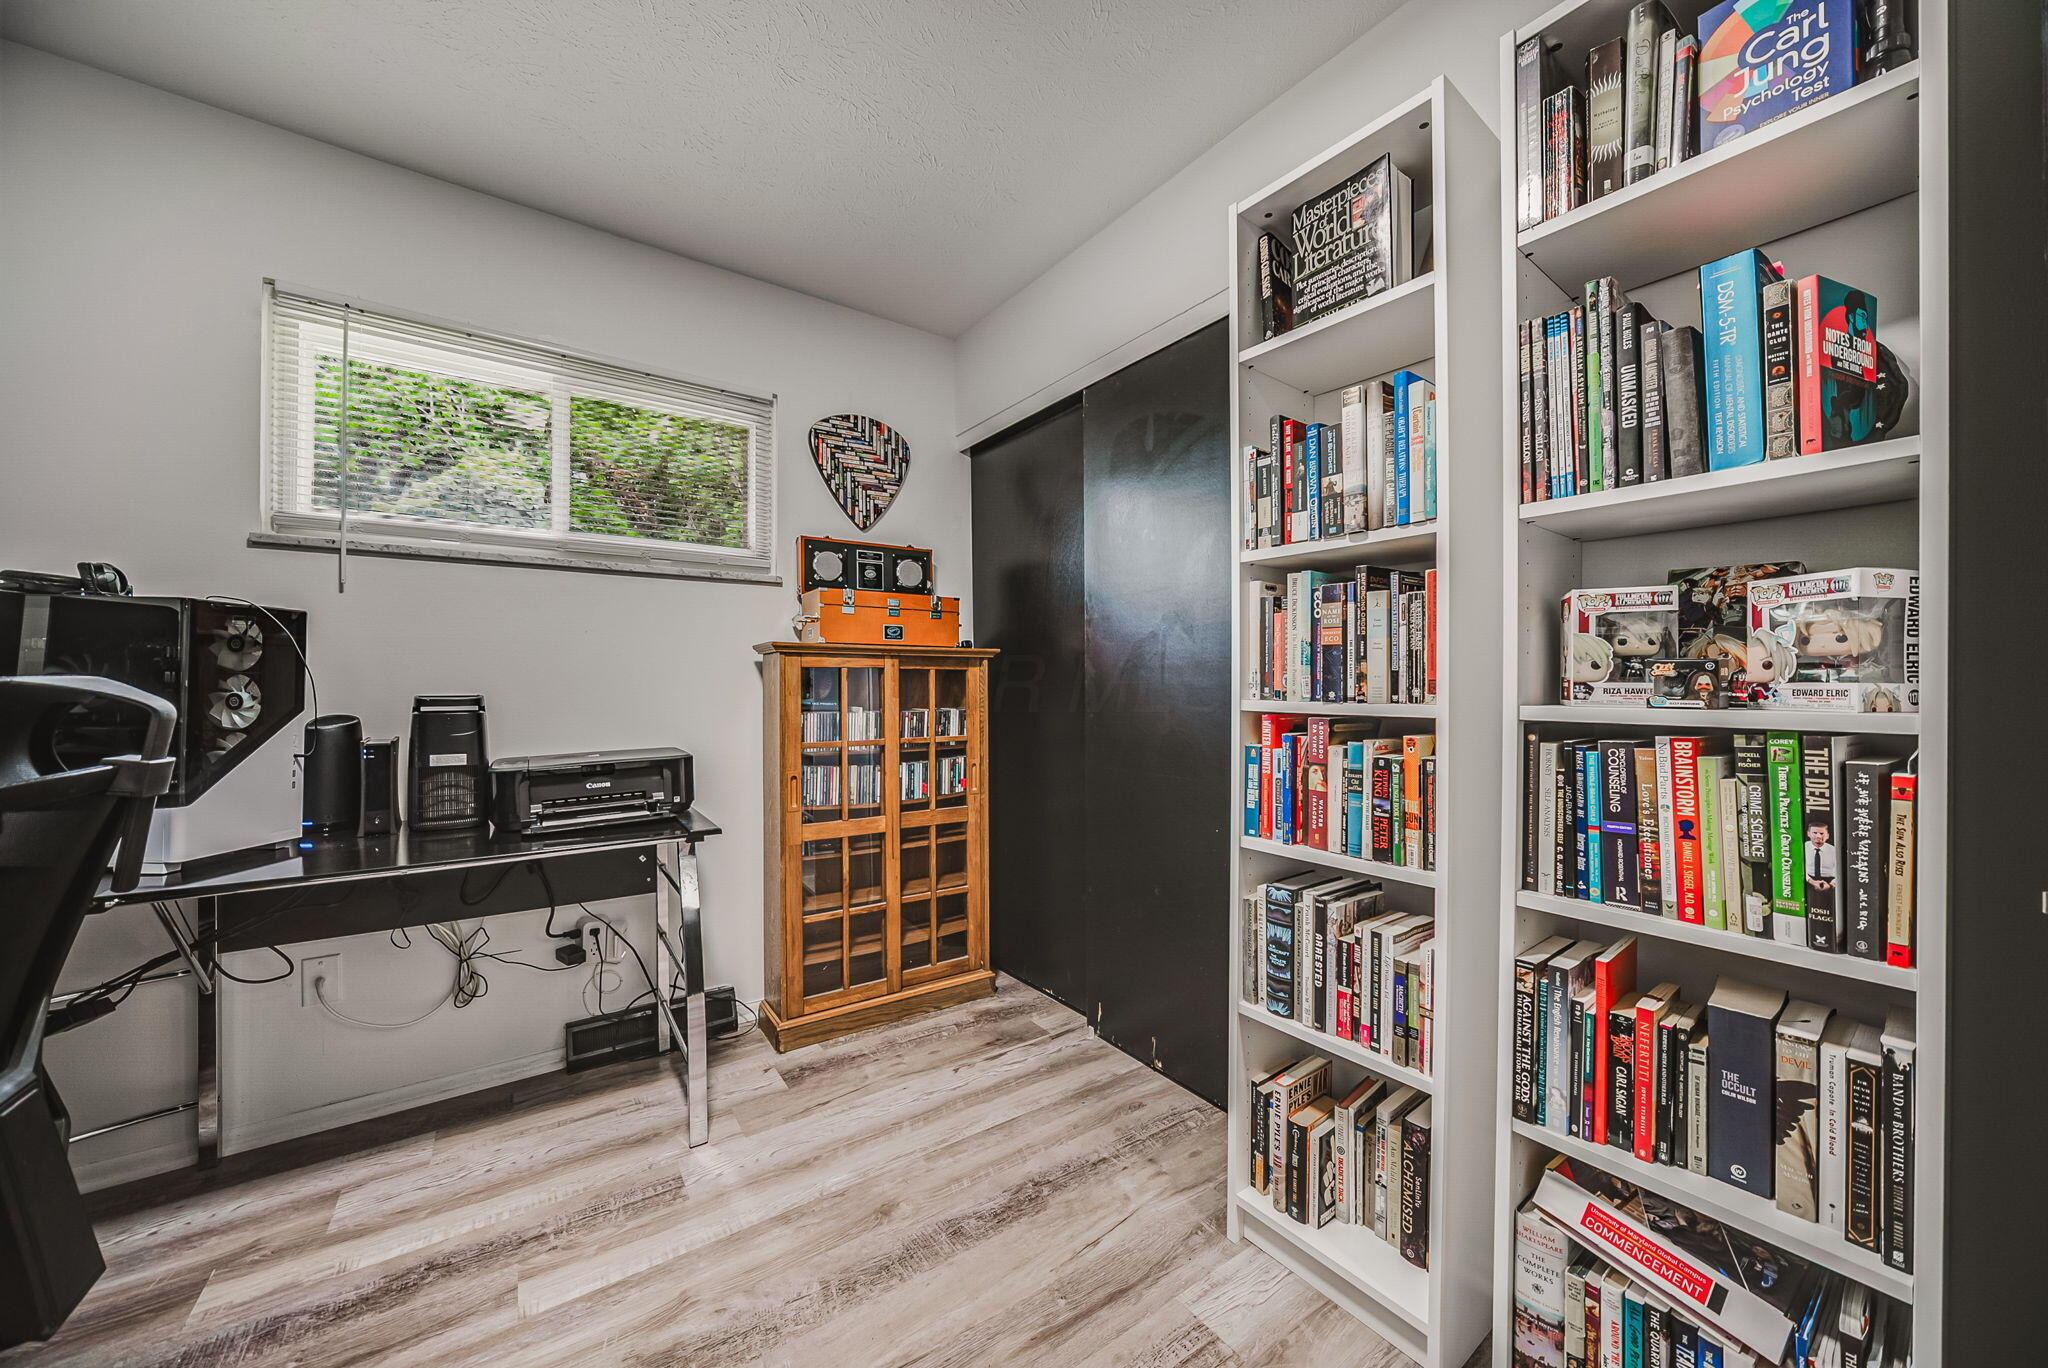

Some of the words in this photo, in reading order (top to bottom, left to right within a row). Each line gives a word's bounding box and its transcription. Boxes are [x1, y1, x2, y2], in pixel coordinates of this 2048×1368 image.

[1786, 9, 1809, 24] The
[1745, 2, 1829, 64] Carl
[1733, 32, 1830, 98] Jung
[1723, 61, 1829, 120] Psychology
[1791, 76, 1829, 102] Test
[1788, 101, 1808, 114] YOUR
[1808, 92, 1829, 105] INNER
[1293, 169, 1386, 235] Masterpieces
[1293, 200, 1352, 259] World
[1320, 215, 1329, 229] of
[1296, 280, 1308, 291] Plot
[1622, 312, 1632, 330] PAUL
[1767, 328, 1788, 339] DANTE
[1770, 321, 1784, 330] THE
[1576, 336, 1584, 370] ARKHAM
[1622, 331, 1633, 350] HOLES
[1769, 336, 1787, 345] CLUB
[1825, 327, 1850, 348] NOTES
[1852, 335, 1872, 355] FROM
[1767, 350, 1789, 360] MATTHEW
[1823, 340, 1874, 369] UNDERGROUND
[1713, 359, 1721, 378] FIFTH
[1723, 355, 1733, 382] MANUAL
[1577, 372, 1585, 405] ASYLUM
[1620, 363, 1637, 429] UNMASKED
[1713, 381, 1721, 409] EDITION
[1725, 382, 1733, 393] OF
[1726, 393, 1735, 419] MENTAL
[1737, 396, 1745, 411] AND
[1385, 414, 1394, 426] THE
[1737, 411, 1747, 449] STATISTICAL
[1385, 429, 1395, 457] PLAGUE
[1715, 426, 1723, 455] REVISION
[1727, 419, 1737, 455] DISORDERS
[1309, 460, 1317, 494] BROWN
[1385, 457, 1395, 481] ALBERT
[1386, 482, 1395, 506] CAMUS
[1906, 576, 1920, 637] EDWARD
[1906, 643, 1920, 684] ELRIC
[1792, 689, 1823, 697] EDWARD
[1826, 689, 1849, 697] ELRIC
[1262, 720, 1271, 746] WINTER
[1312, 724, 1318, 735] DA
[1262, 747, 1271, 775] COUNTS
[1658, 742, 1668, 756] No
[1804, 748, 1829, 776] THE
[1619, 748, 1627, 786] ENCYCLOPEDIA
[1659, 757, 1670, 775] Bad
[1674, 741, 1695, 817] BRAINSTORM
[586, 781, 611, 792] Canon
[1373, 770, 1383, 797] KING
[1607, 748, 1621, 813] COUNSELING
[1620, 786, 1627, 794] OF
[1660, 776, 1670, 800] Parts
[1641, 783, 1653, 815] Love's
[1749, 785, 1761, 816] CRIME
[1805, 778, 1830, 814] DEAL
[1543, 787, 1552, 838] SELF-ANALYSIS
[1896, 813, 1907, 825] THE
[1379, 818, 1389, 849] PETER
[1751, 818, 1765, 857] SCIENCE
[1896, 827, 1907, 840] SUN
[1640, 818, 1653, 880] Executioner
[1895, 841, 1907, 858] ALSO
[1895, 860, 1906, 876] RISES
[1314, 933, 1323, 988] ARRESTED
[1553, 989, 1562, 1001] The
[1522, 994, 1531, 1043] AGAINST
[1552, 1002, 1562, 1025] English
[1522, 1047, 1531, 1070] THE
[1553, 1026, 1561, 1065] Renaissance
[1638, 1021, 1650, 1082] NEFERTITI
[1780, 1055, 1812, 1070] DEVIL
[1828, 1054, 1836, 1079] Truman
[1289, 1076, 1312, 1100] ERNIE
[1515, 1076, 1522, 1085] OF
[1521, 1072, 1531, 1104] GODS
[1616, 1066, 1627, 1088] CARL
[1721, 1070, 1740, 1083] THE
[1721, 1079, 1757, 1097] OCCULT
[1892, 1073, 1904, 1106] BAND
[1616, 1090, 1627, 1116] SAGAN
[1828, 1081, 1836, 1105] Capote
[1390, 1146, 1397, 1158] Am
[1829, 1135, 1837, 1156] Blood
[1892, 1120, 1905, 1184] BROTHERS
[1402, 1139, 1414, 1234] ALCHEMISED
[1414, 1176, 1422, 1208] SenLinYu
[1515, 1232, 1563, 1255] SHAKESPEARE
[1521, 1225, 1555, 1244] WILLIAM
[1590, 1206, 1620, 1230] University
[1619, 1226, 1627, 1234] of
[1626, 1228, 1656, 1253] Maryland
[1656, 1244, 1678, 1266] Global
[1678, 1258, 1707, 1285] Campus
[1516, 1254, 1561, 1279] COMPLETE
[1529, 1252, 1546, 1263] THE
[1583, 1216, 1704, 1298] COMMENCEMENT
[1523, 1266, 1554, 1285] WORKS
[1650, 1310, 1659, 1331] THE
